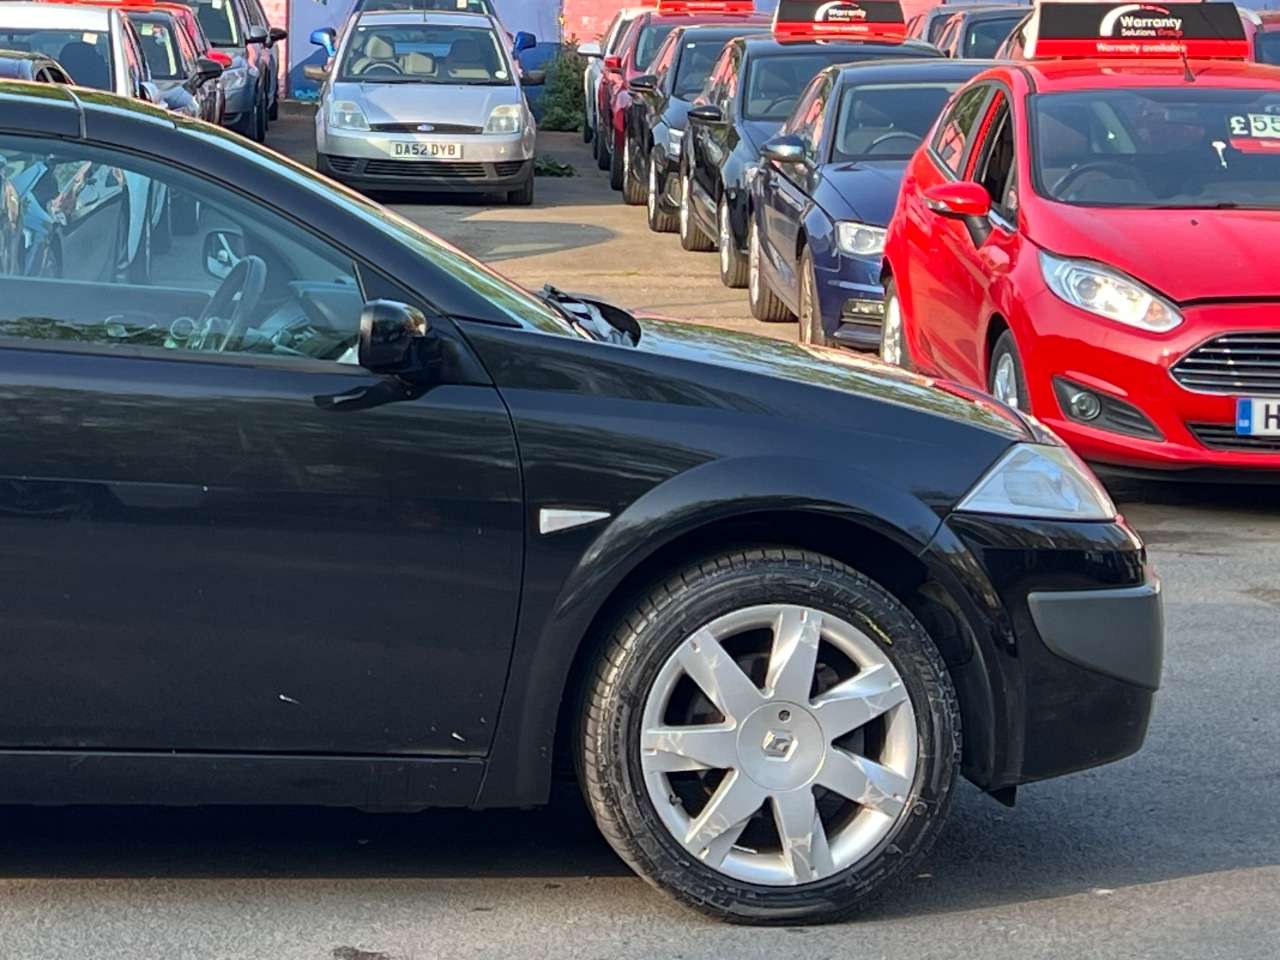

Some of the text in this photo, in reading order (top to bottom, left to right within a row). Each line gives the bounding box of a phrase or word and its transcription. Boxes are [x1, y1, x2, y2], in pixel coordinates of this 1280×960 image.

[1120, 16, 1182, 31] Warranty
[1121, 28, 1156, 37] Solutions
[1096, 43, 1140, 54] Warranty
[395, 143, 456, 156] DA52 DYB
